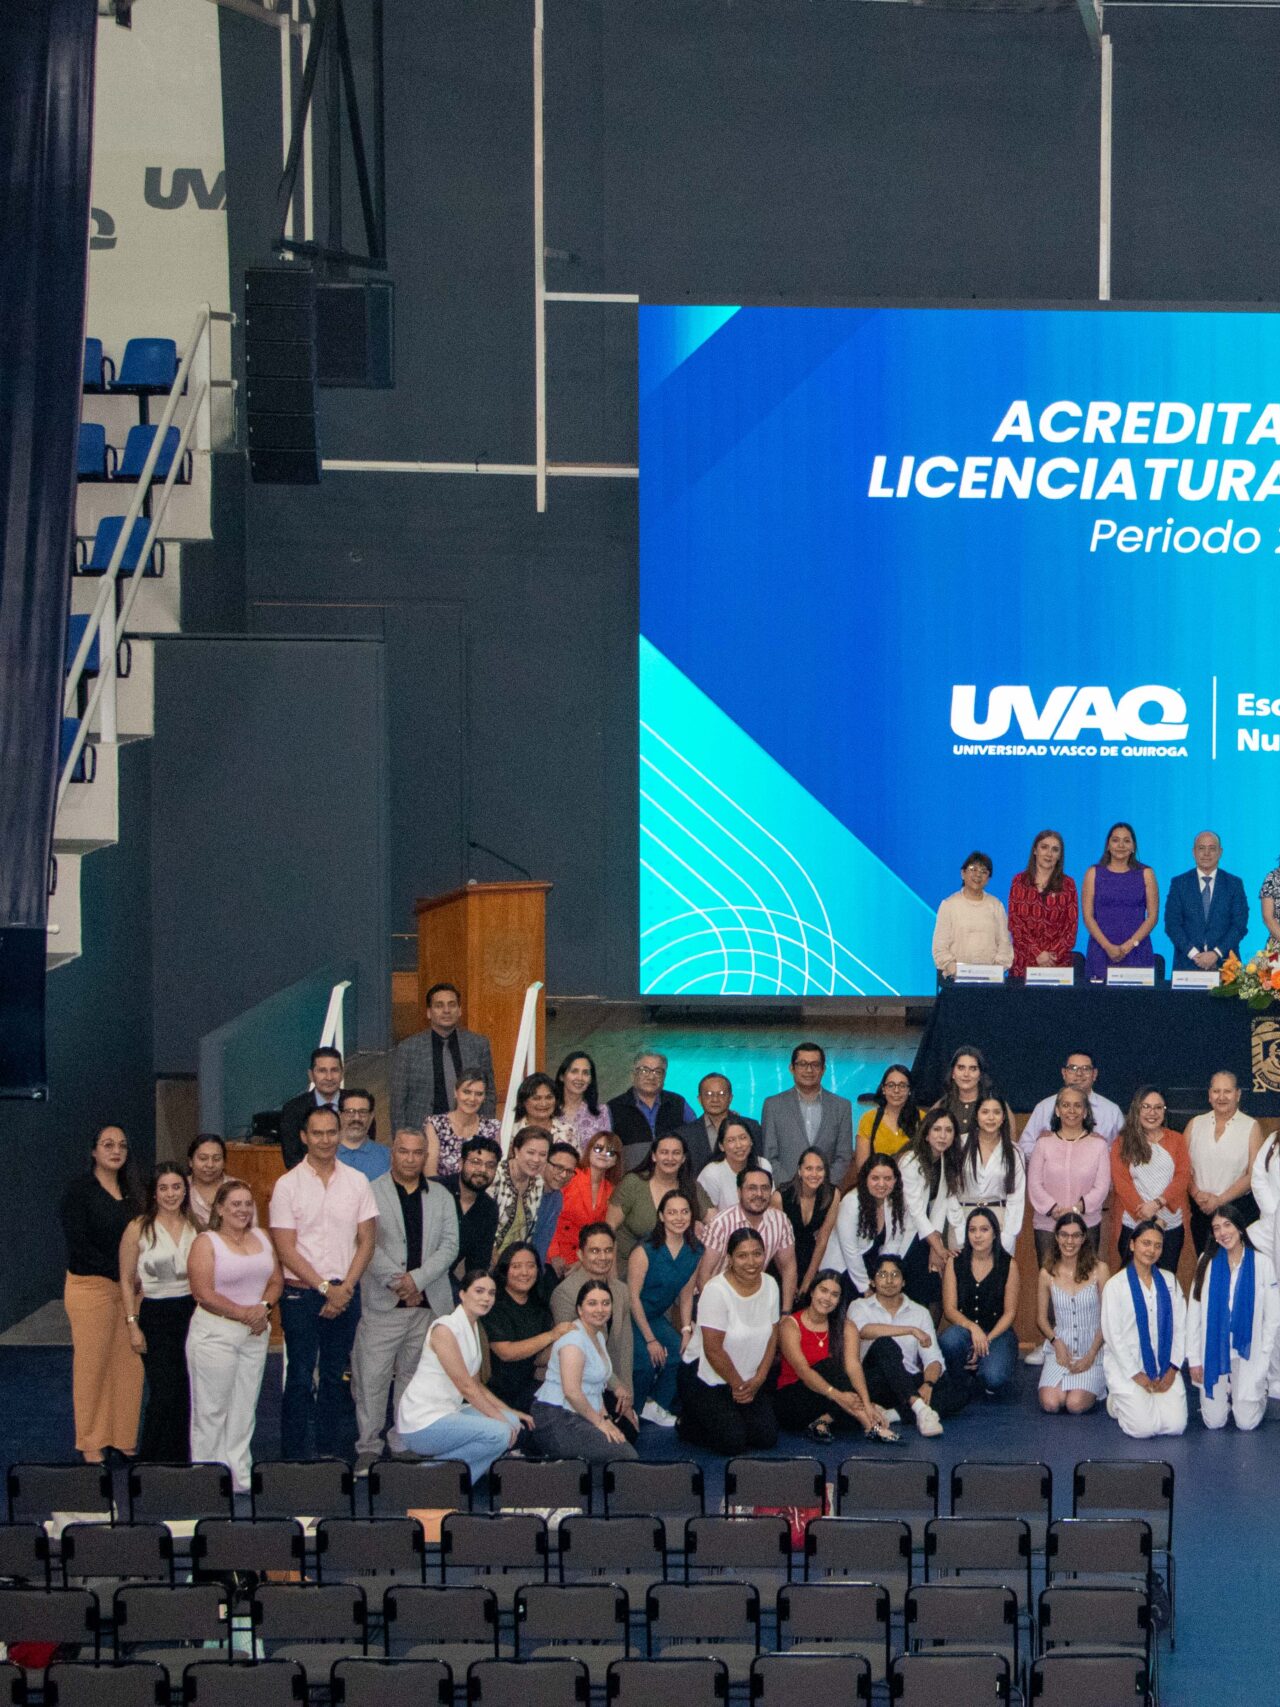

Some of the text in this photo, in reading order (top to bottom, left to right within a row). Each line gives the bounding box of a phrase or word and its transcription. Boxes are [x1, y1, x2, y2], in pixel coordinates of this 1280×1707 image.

[1089, 518, 1261, 554] Periodo
[950, 684, 1189, 741] UVAQ
[953, 744, 1188, 757] UNIVERSIDAD VASCO DE QUIROGA
